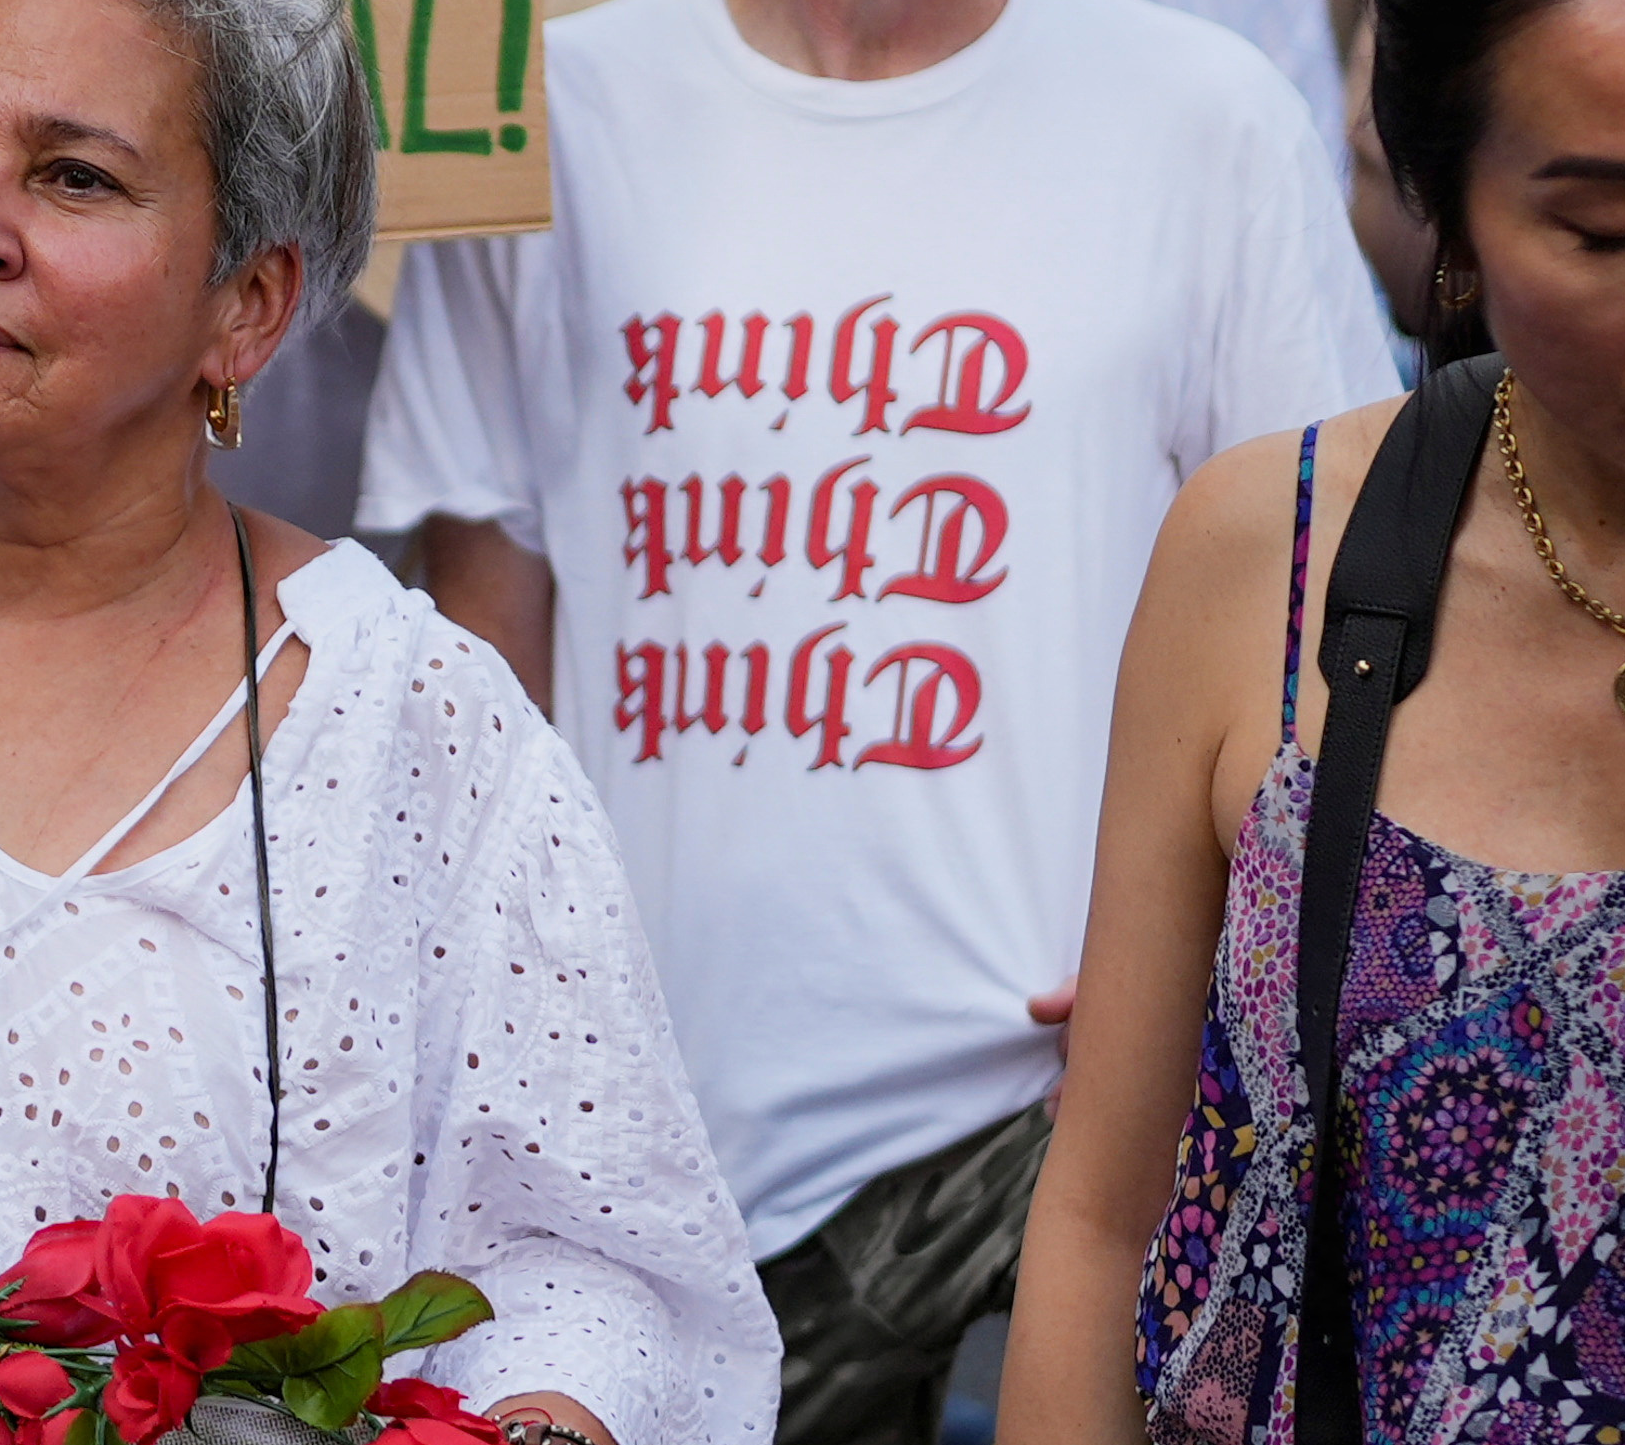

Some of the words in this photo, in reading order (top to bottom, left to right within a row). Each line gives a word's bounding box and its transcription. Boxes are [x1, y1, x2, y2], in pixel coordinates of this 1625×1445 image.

[619, 292, 1032, 436] Think
[620, 454, 1009, 604] Think
[613, 621, 984, 771] Think
